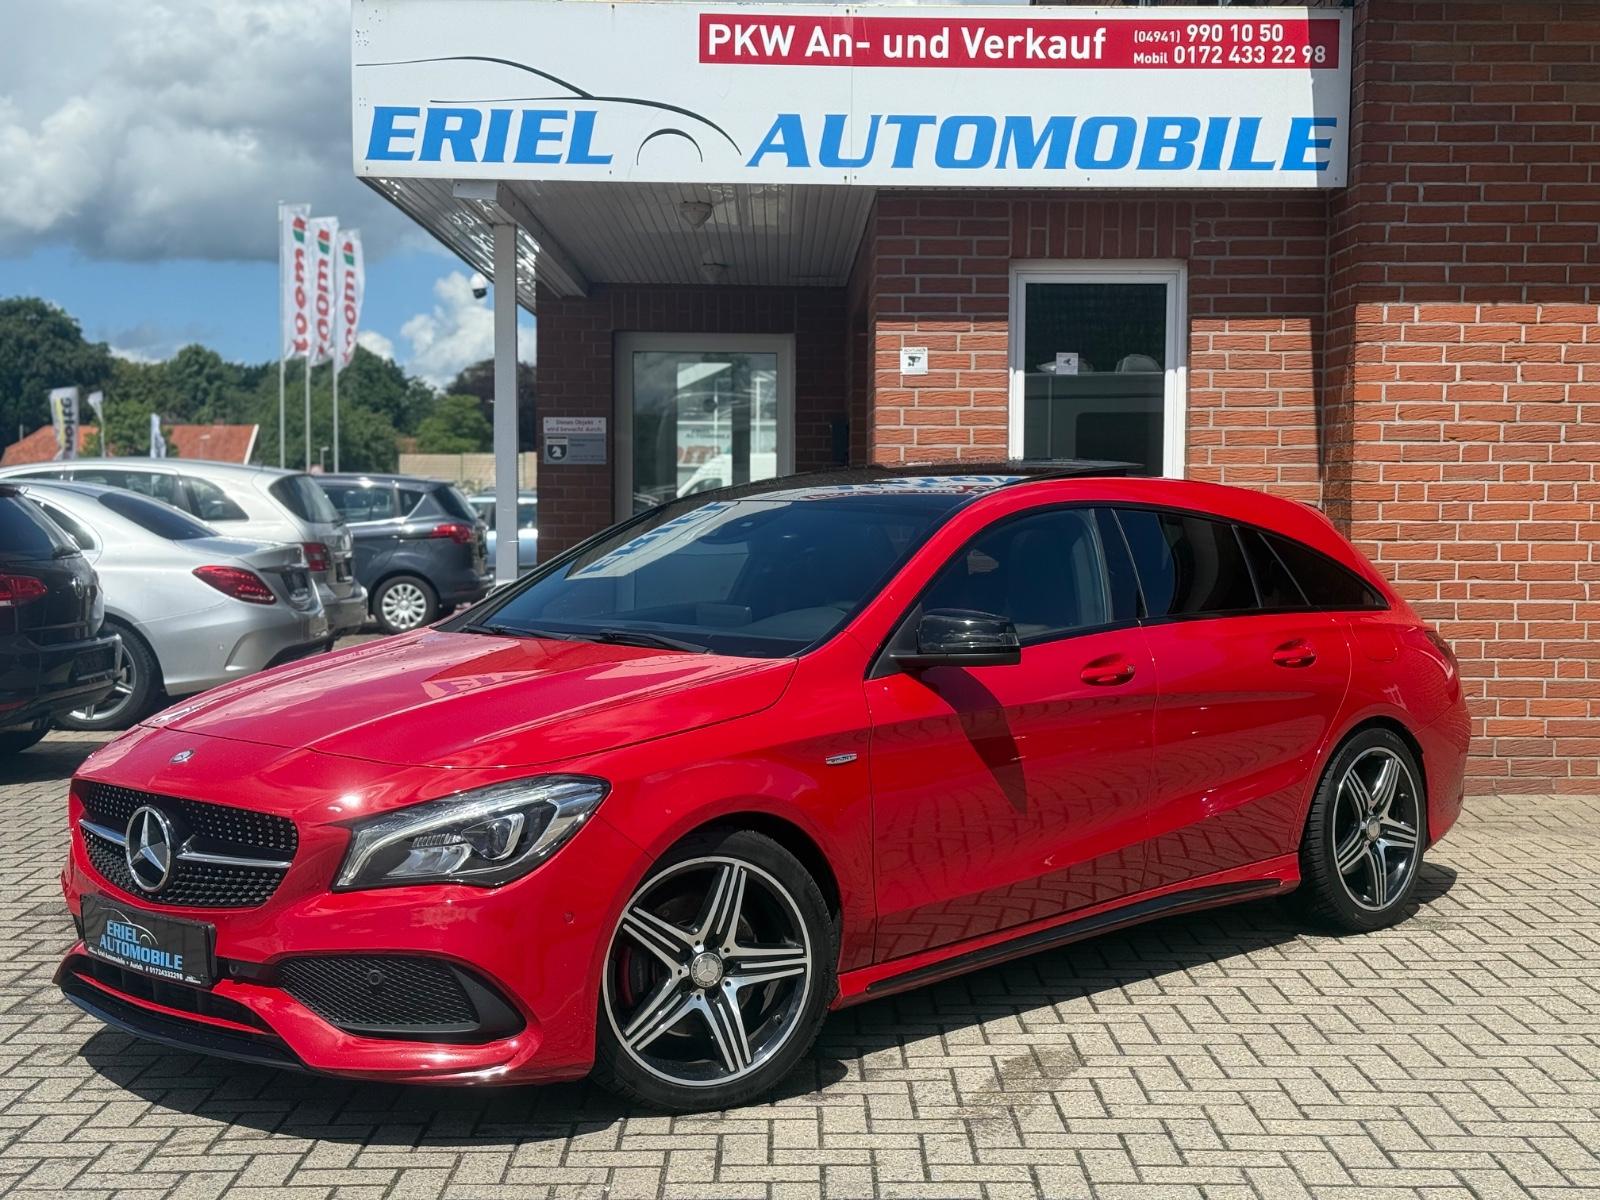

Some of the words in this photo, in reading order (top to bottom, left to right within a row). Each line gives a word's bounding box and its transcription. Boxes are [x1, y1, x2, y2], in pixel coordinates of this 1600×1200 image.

[708, 23, 796, 57] PKW
[804, 25, 871, 58] An-
[883, 26, 950, 60] und
[960, 26, 1107, 60] Verkauf
[1133, 30, 1175, 44] (04941)
[1186, 23, 1223, 43] 990
[1230, 23, 1254, 43] 10
[1259, 23, 1284, 43] 50
[1133, 51, 1169, 64] Mobil
[1173, 45, 1223, 65] 0172
[1228, 45, 1266, 64] 433
[1271, 44, 1296, 64] 22
[1301, 44, 1326, 64] 98
[366, 105, 613, 166] ERIEL
[746, 112, 1337, 172] AUTOMOBILE
[106, 920, 139, 944] ERIEL
[100, 934, 182, 970] AUTOMOBILE
